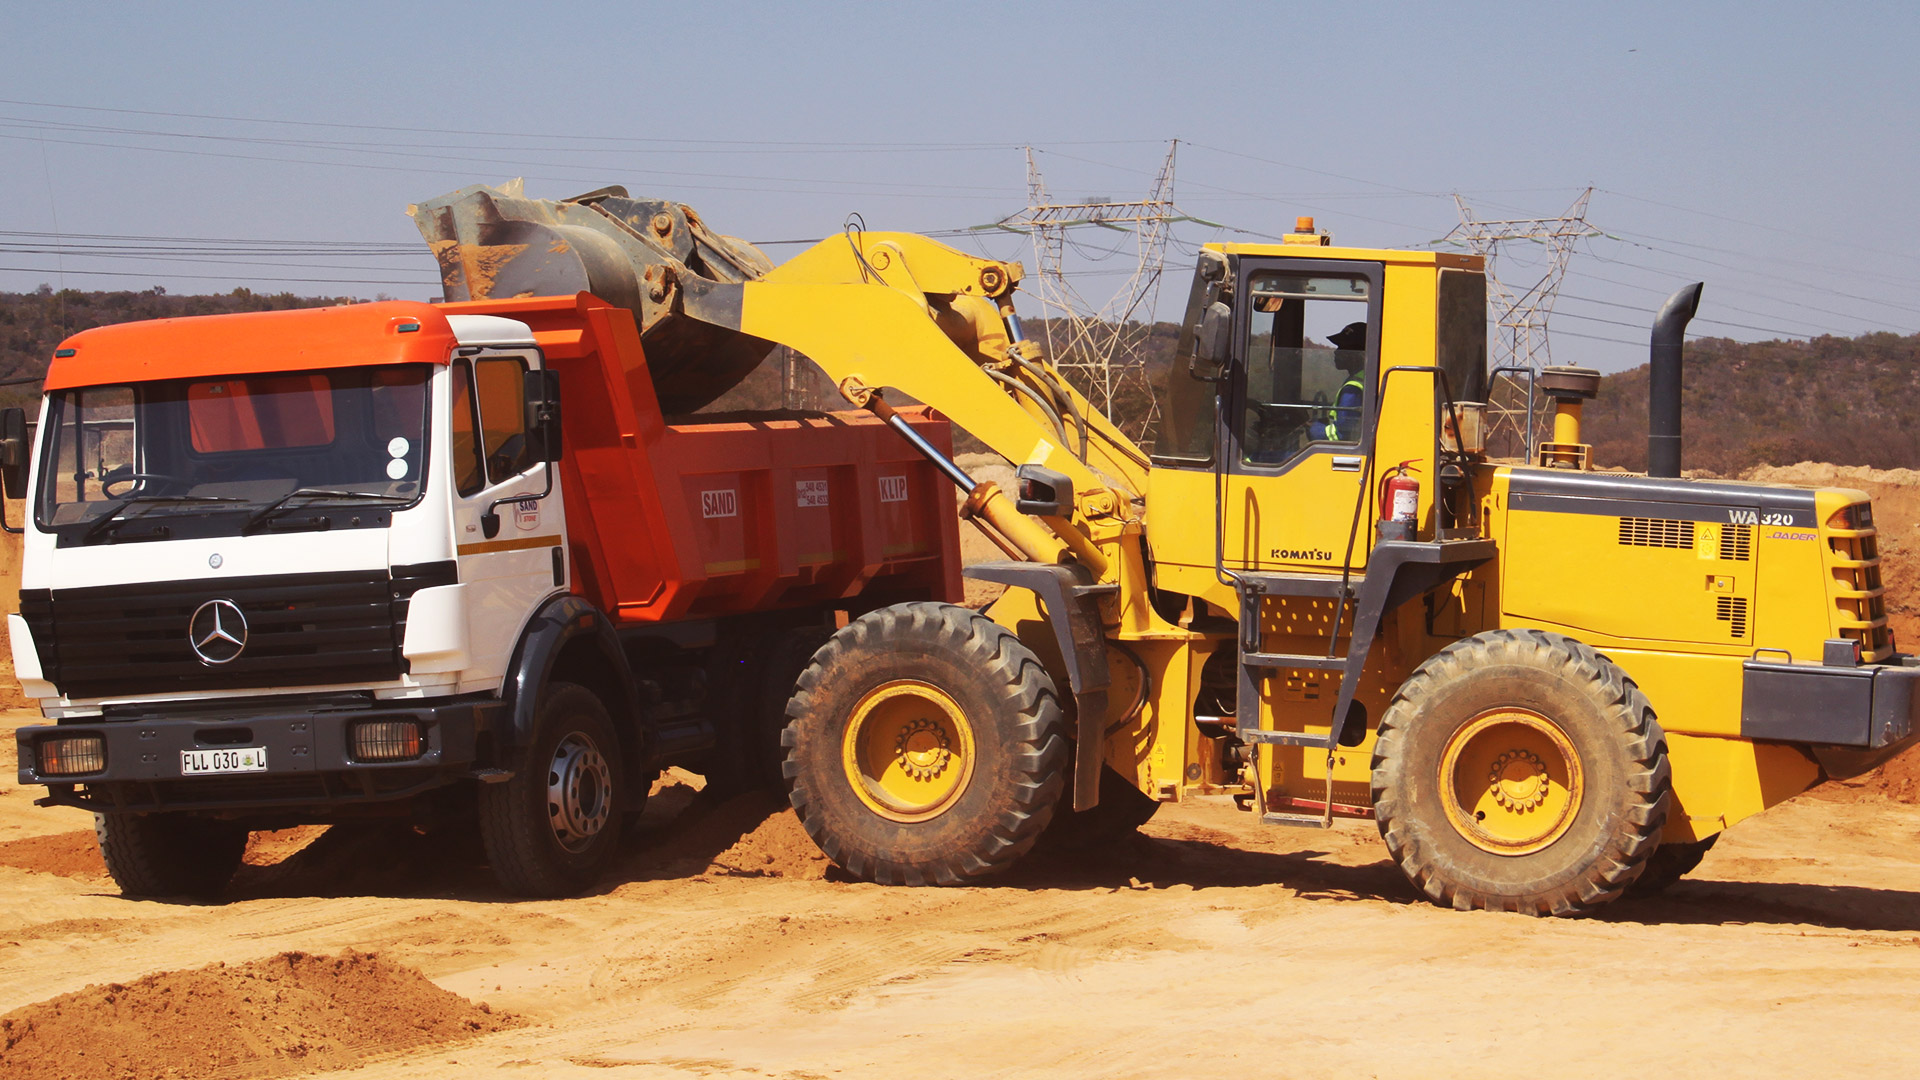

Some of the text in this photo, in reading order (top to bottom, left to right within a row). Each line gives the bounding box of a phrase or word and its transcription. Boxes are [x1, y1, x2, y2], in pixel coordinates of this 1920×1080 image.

[880, 478, 905, 500] KLIP
[520, 500, 538, 511] SAND
[703, 492, 735, 516] SAND
[1728, 510, 1794, 526] WA 320
[1766, 531, 1816, 542] OADER
[1271, 548, 1332, 560] KOMATSU
[183, 751, 265, 771] FLL 030 L
